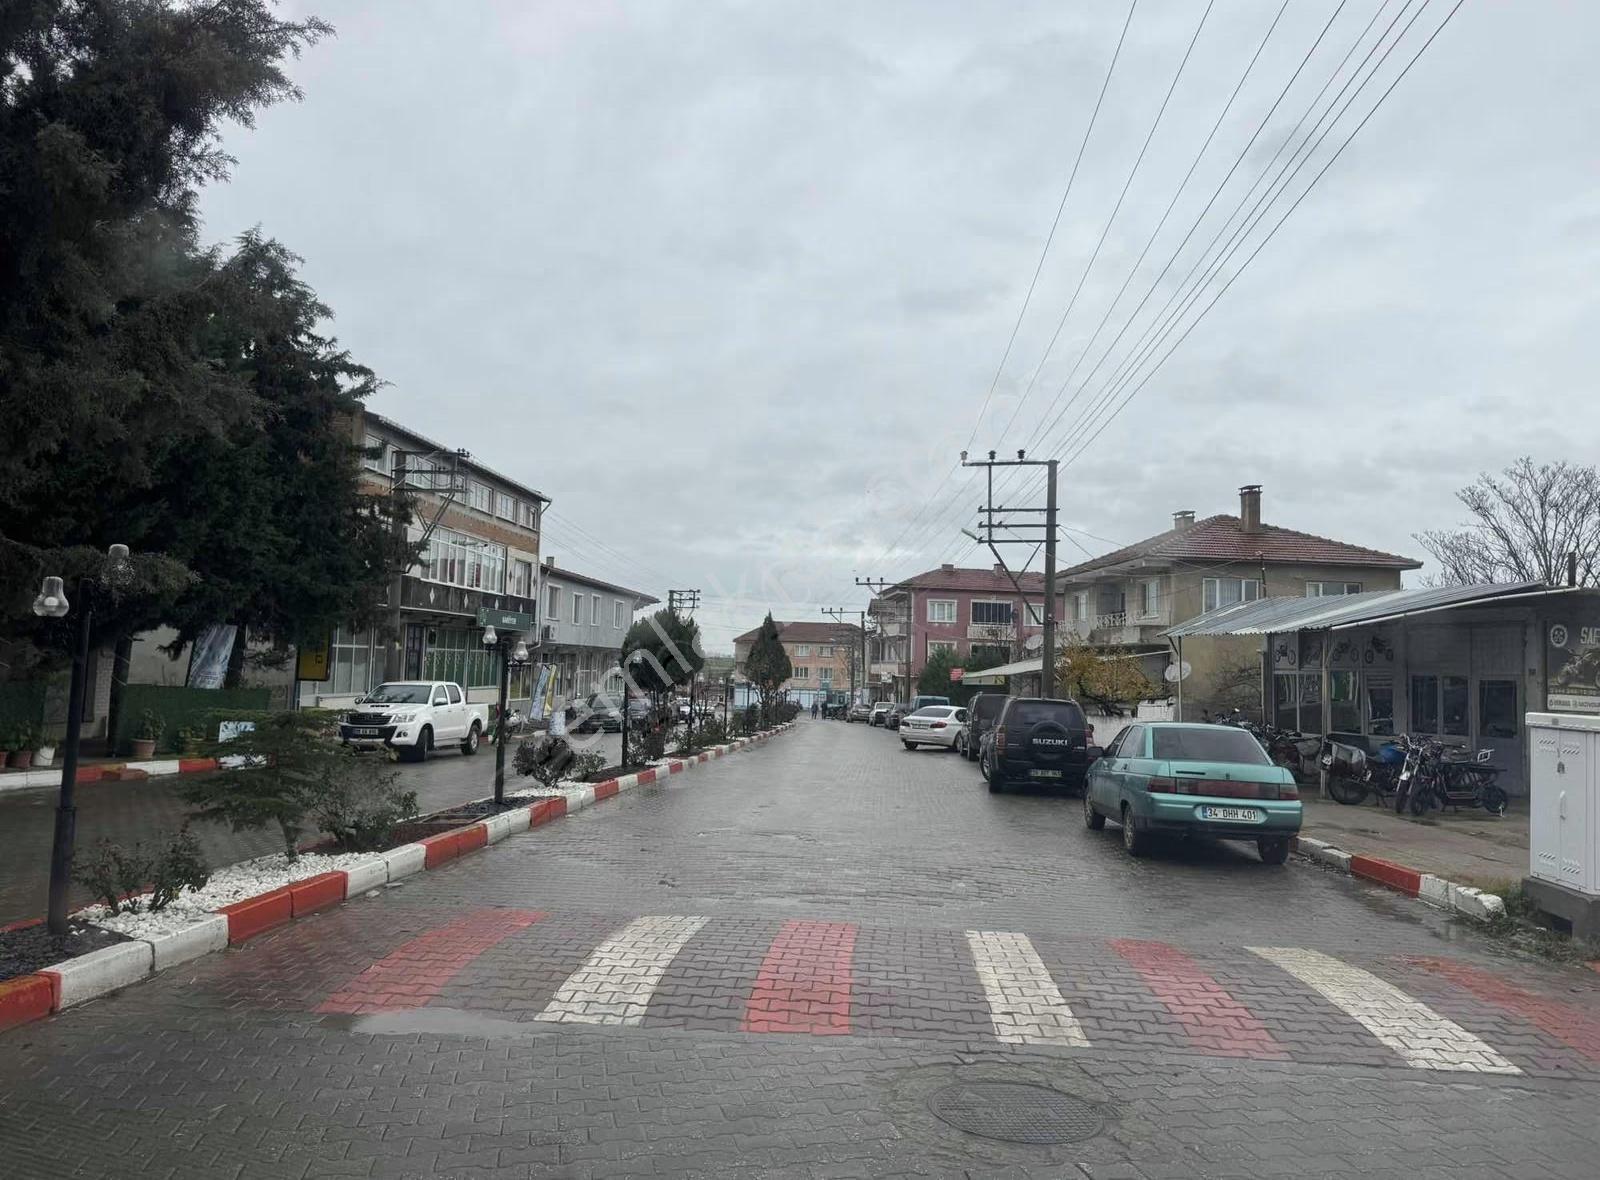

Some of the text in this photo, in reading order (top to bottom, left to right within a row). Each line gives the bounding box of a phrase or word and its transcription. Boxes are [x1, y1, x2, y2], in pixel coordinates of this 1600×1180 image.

[1032, 738, 1068, 746] SUZUKI
[1207, 807, 1218, 817] 34
[1242, 810, 1256, 819] 401
